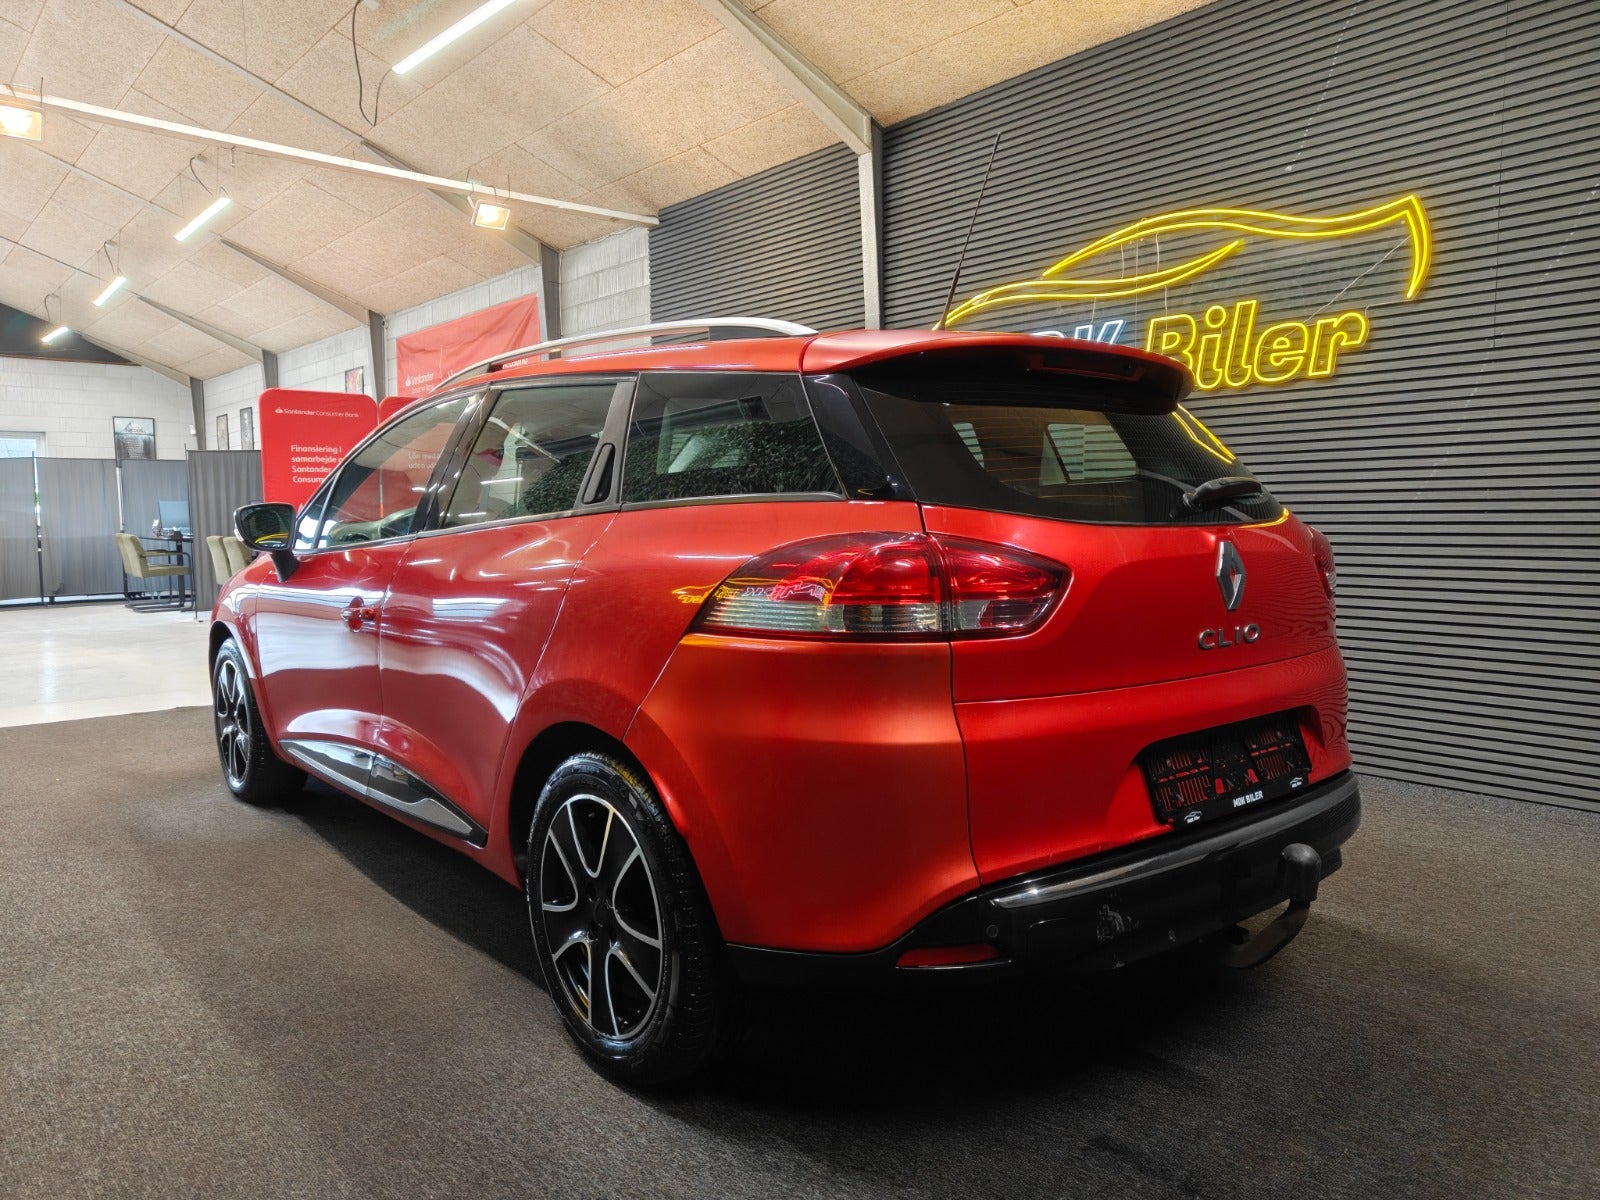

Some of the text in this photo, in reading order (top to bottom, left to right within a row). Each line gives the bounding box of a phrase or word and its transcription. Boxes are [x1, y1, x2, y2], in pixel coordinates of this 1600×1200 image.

[1147, 300, 1367, 390] Biler
[283, 408, 315, 416] Santander
[290, 444, 338, 455] Finansiering
[291, 455, 337, 465] samarbejde
[291, 465, 332, 473] Santander
[292, 475, 324, 483] Consum
[1198, 624, 1260, 650] CLIO
[1245, 790, 1264, 804] BILER
